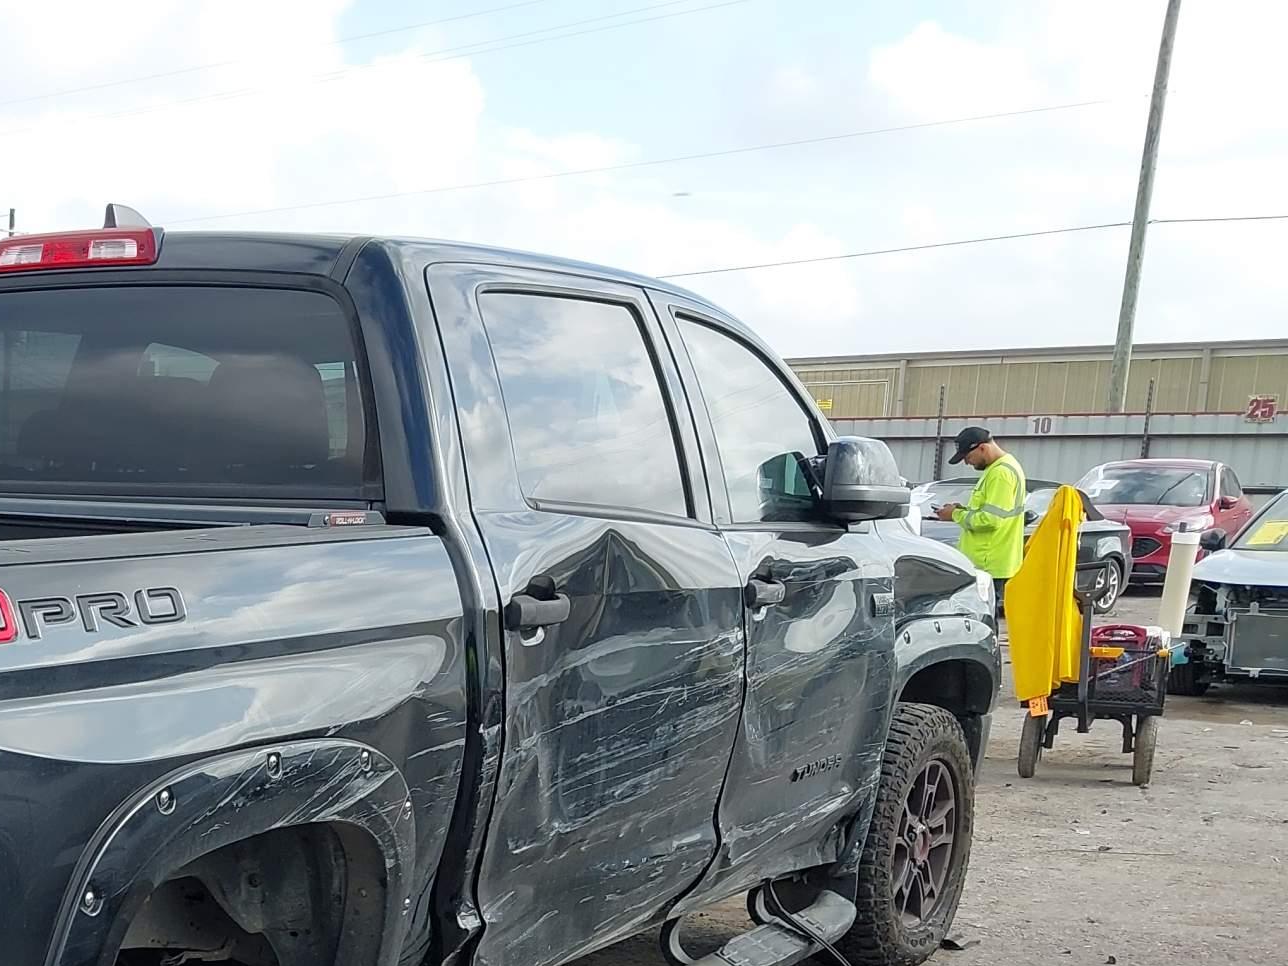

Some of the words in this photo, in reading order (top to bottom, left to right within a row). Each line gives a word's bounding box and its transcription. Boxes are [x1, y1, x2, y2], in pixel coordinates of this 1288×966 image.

[1246, 398, 1275, 418] 25
[1032, 417, 1052, 434] 10
[17, 586, 187, 640] PRO
